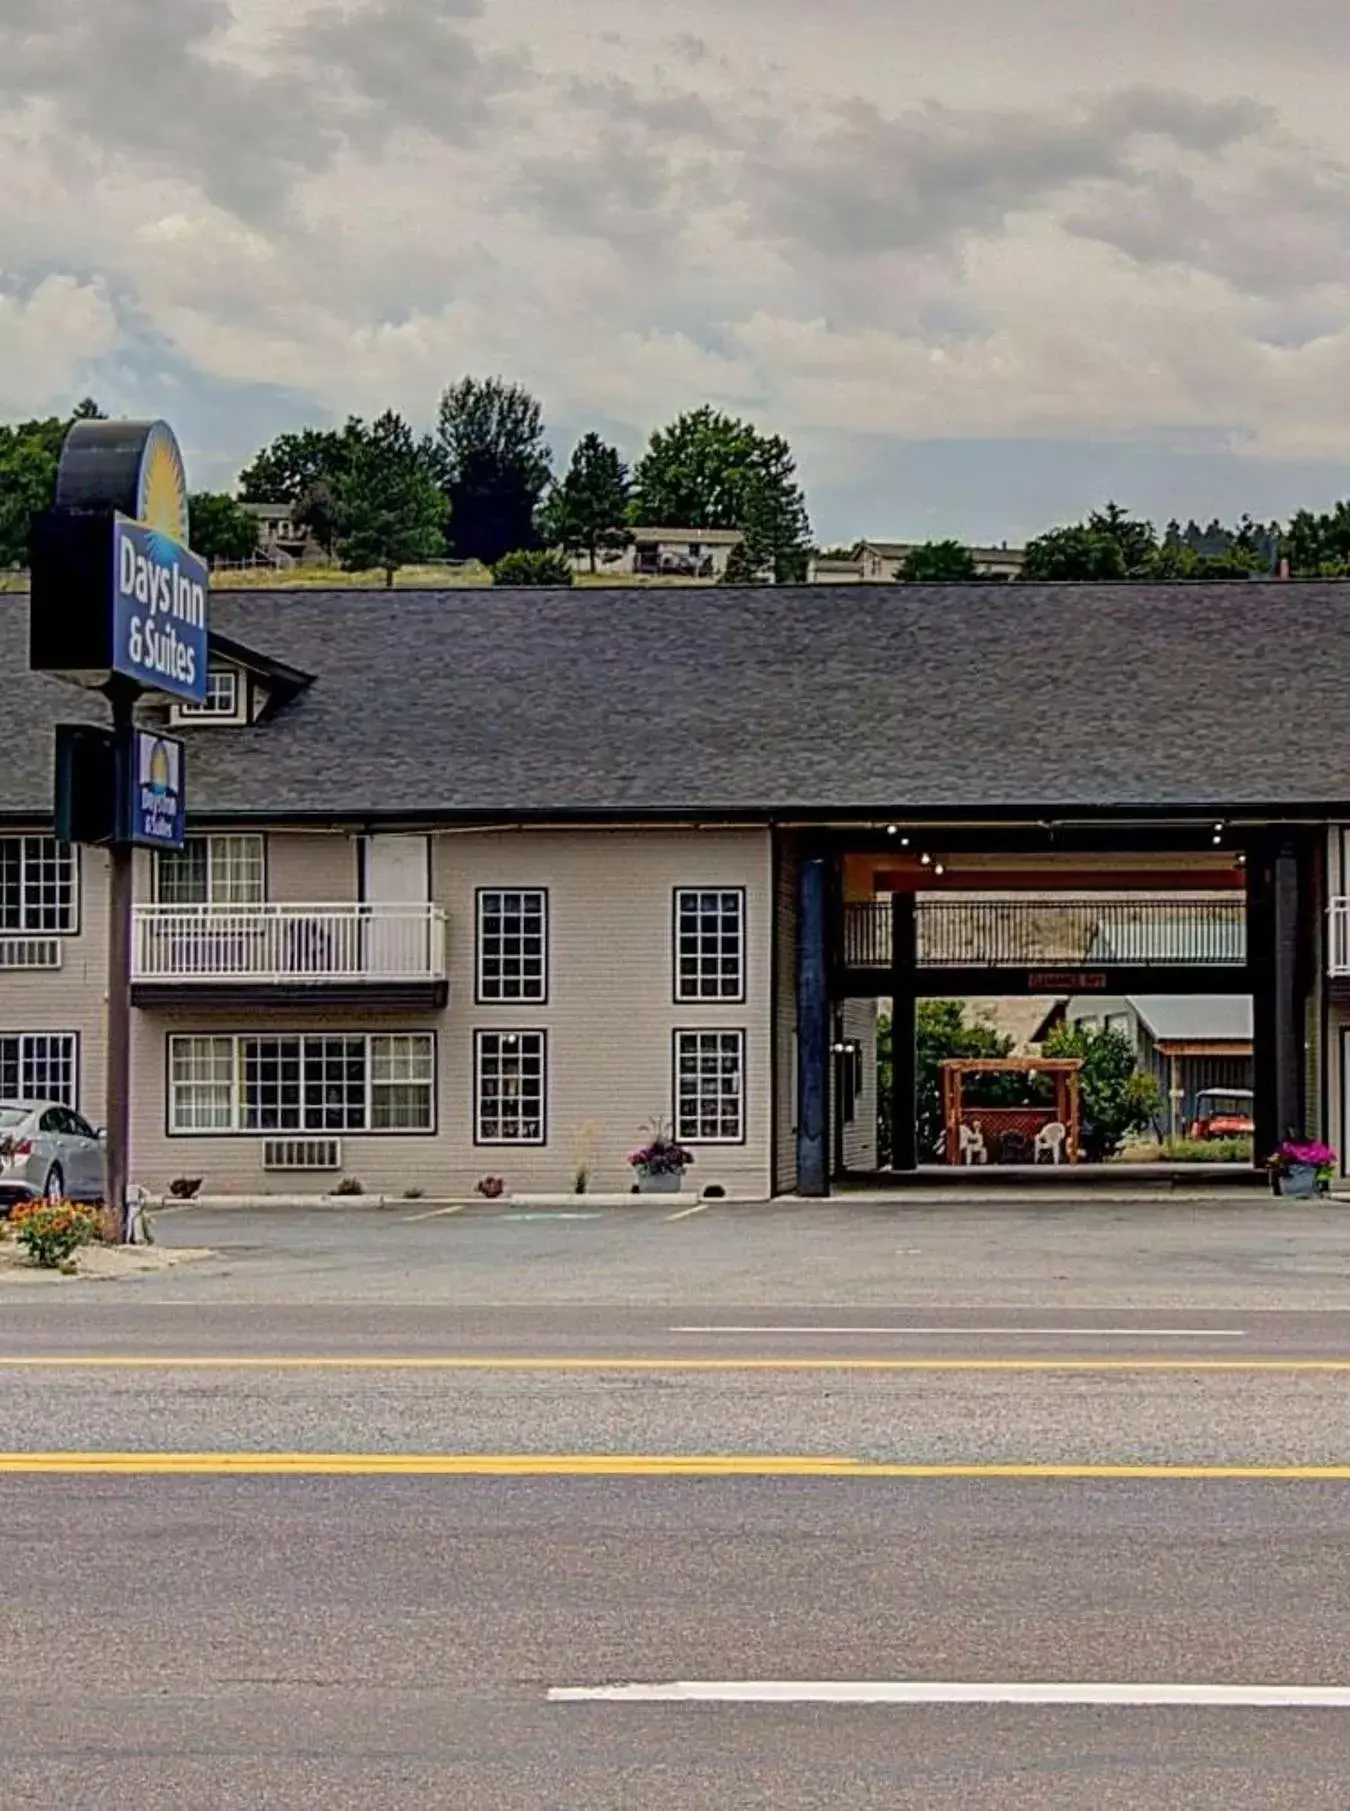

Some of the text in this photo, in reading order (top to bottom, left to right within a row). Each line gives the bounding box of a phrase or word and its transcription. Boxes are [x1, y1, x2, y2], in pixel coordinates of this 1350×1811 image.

[119, 534, 205, 630] Days Inn
[128, 615, 196, 685] & Suites
